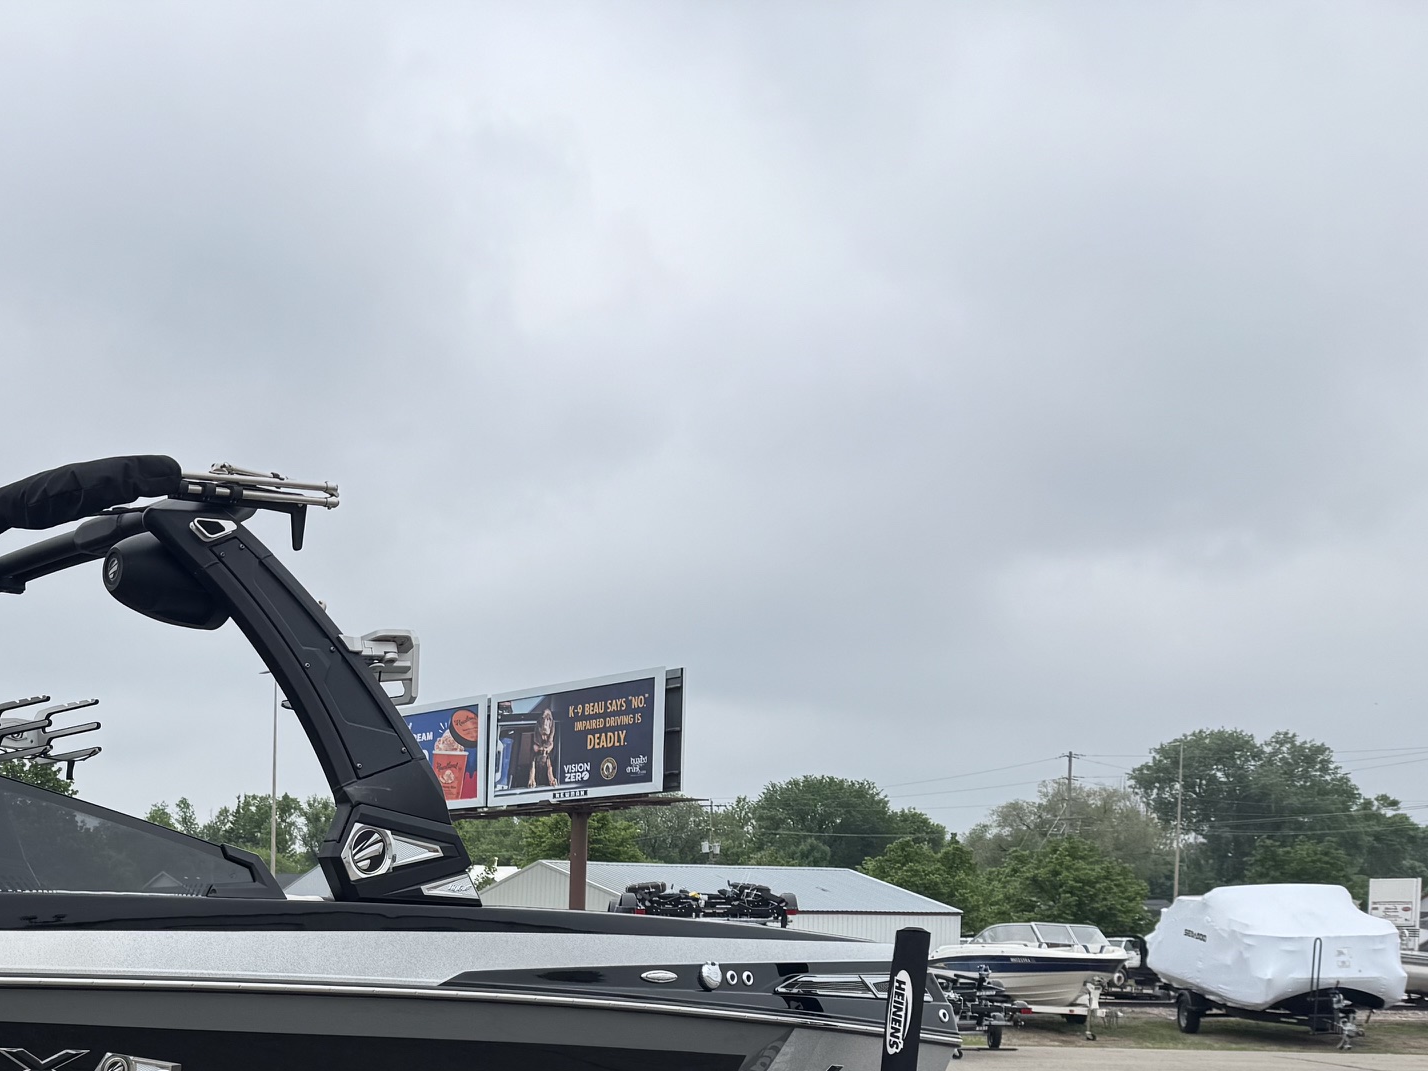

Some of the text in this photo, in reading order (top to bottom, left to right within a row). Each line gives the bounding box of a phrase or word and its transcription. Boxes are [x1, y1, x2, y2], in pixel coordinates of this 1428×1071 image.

[568, 704, 583, 718] K-9
[584, 701, 605, 716] BEAU
[606, 698, 626, 712] SAYS
[574, 713, 642, 731] IMPAIRED DRIVING IS
[586, 730, 628, 750] DEADLY.
[563, 762, 591, 774] VISION
[564, 771, 590, 783] ZERO
[888, 978, 907, 1053] HEINEN'S
